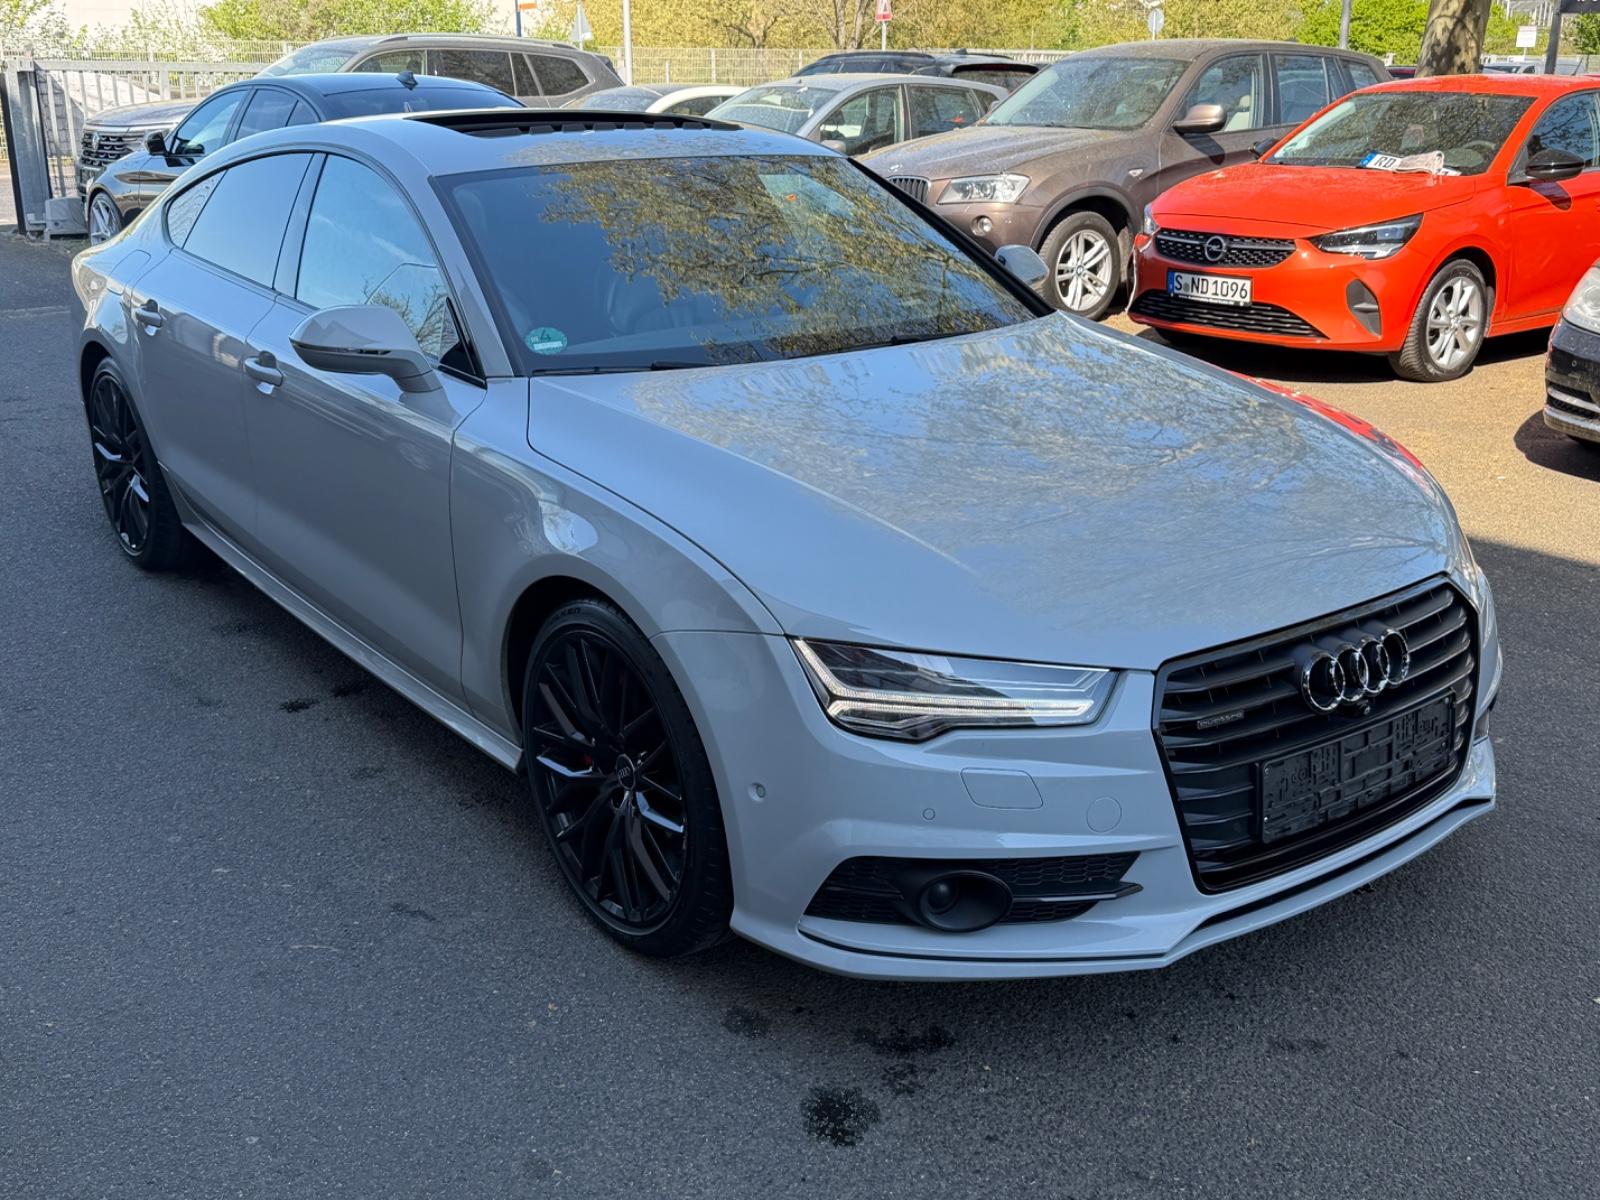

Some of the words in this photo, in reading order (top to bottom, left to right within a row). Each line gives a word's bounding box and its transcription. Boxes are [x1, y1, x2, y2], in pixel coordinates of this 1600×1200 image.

[1374, 155, 1397, 168] RD
[1175, 274, 1183, 291] S
[1190, 277, 1209, 294] ND
[1211, 280, 1248, 299] 1096
[540, 329, 552, 341] 4
